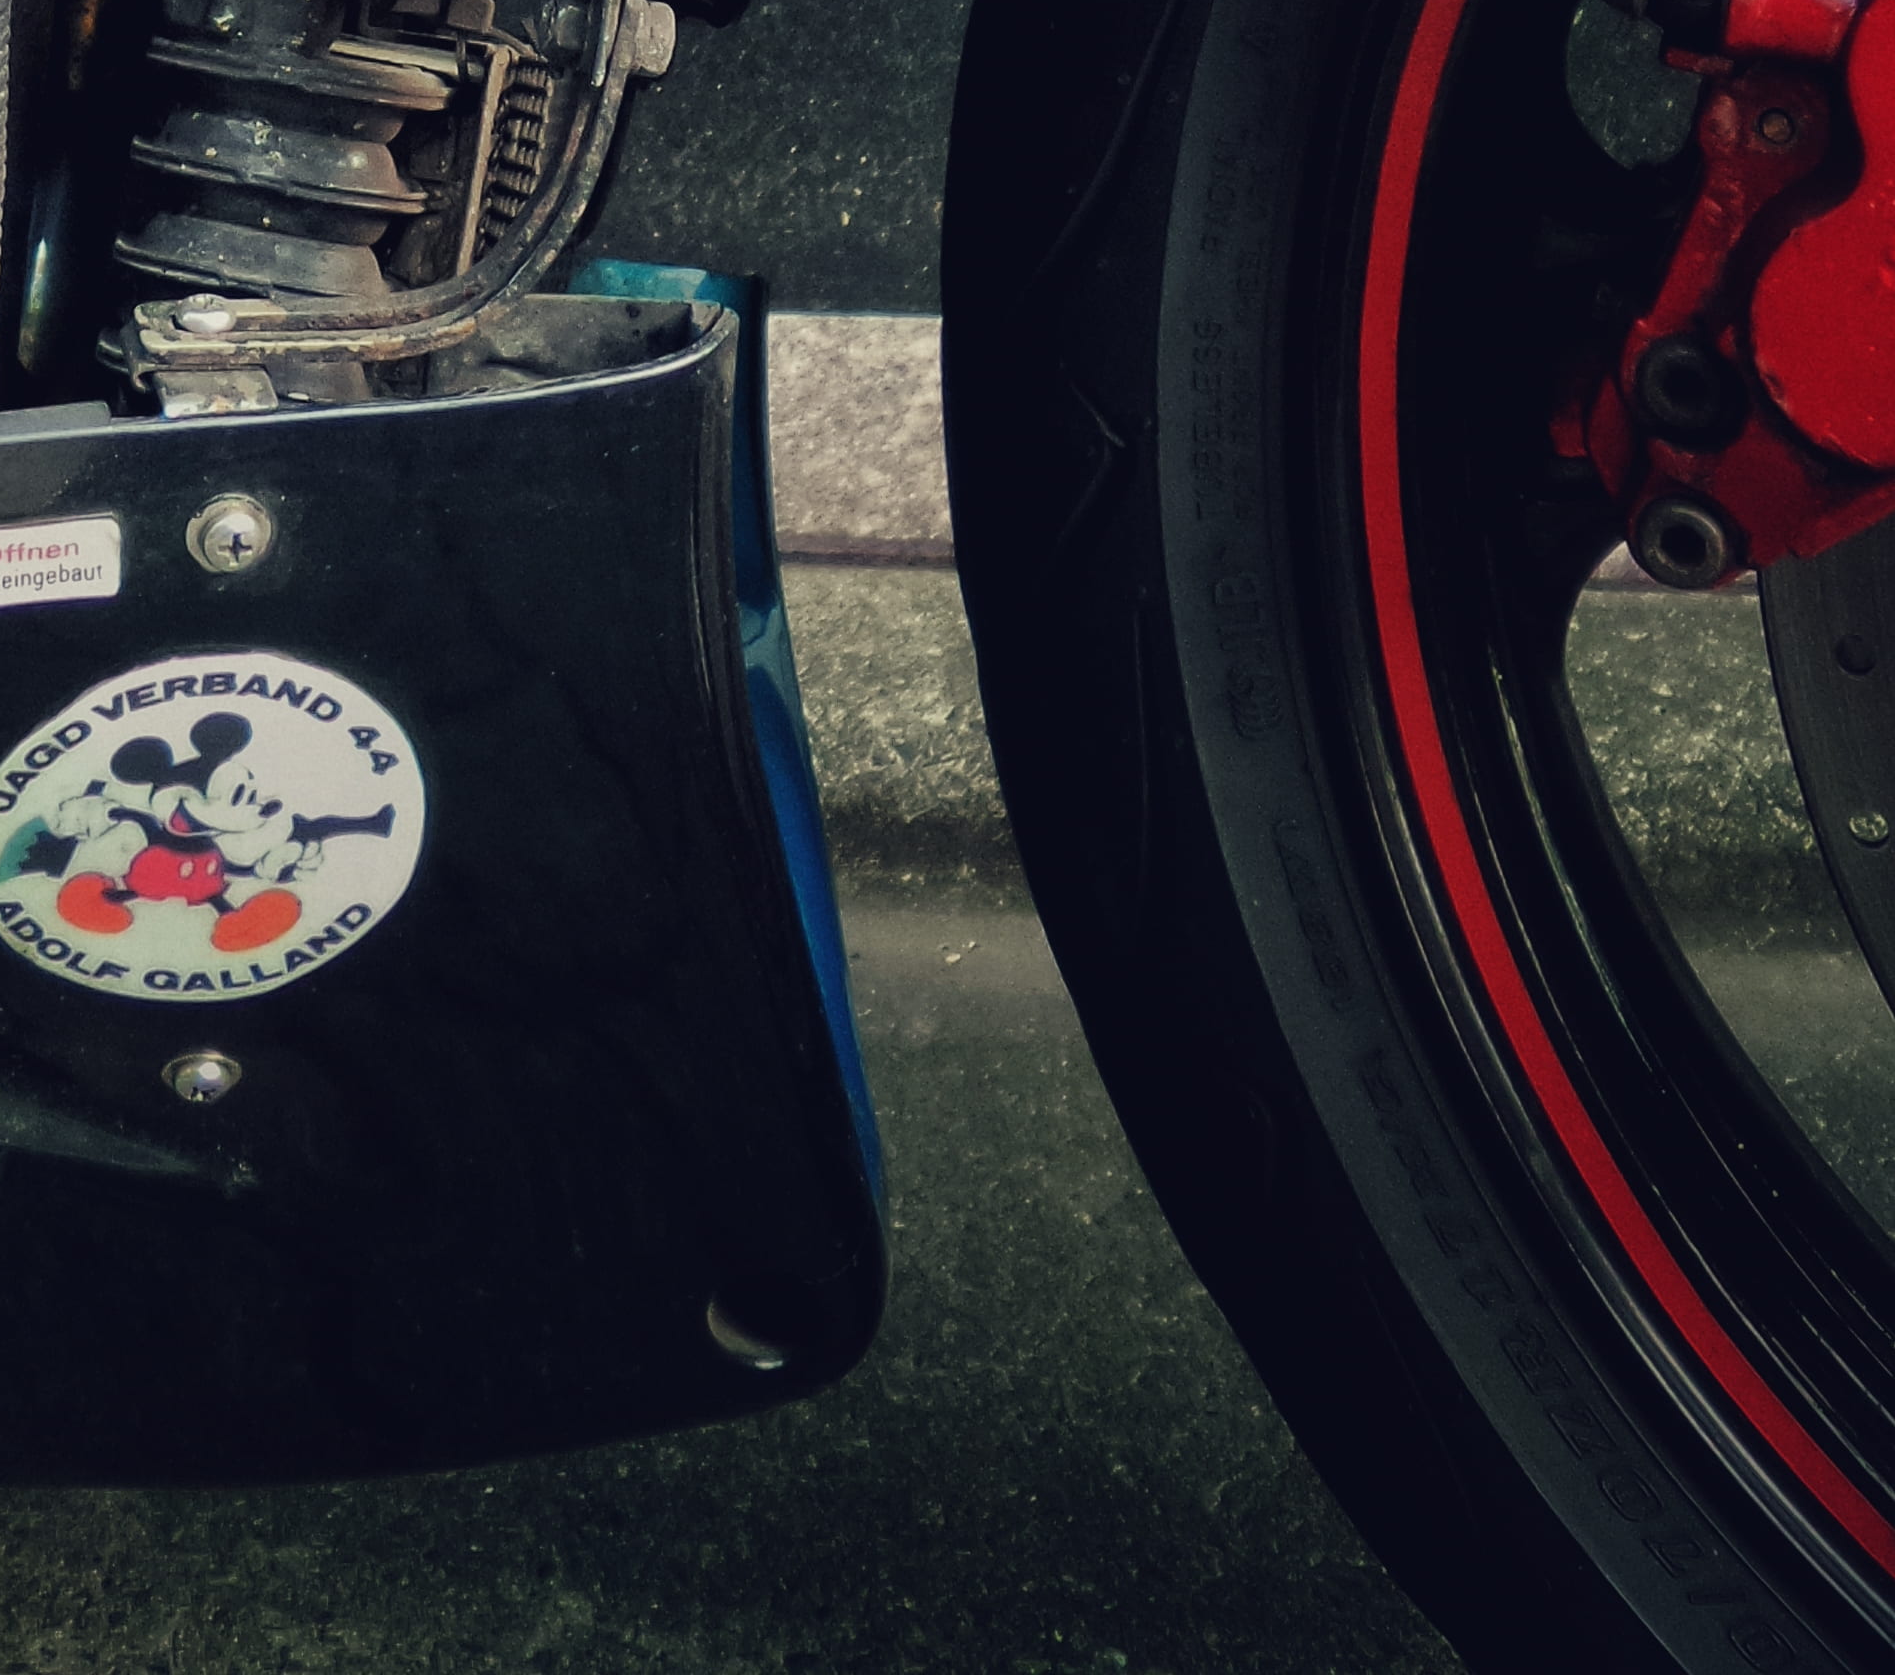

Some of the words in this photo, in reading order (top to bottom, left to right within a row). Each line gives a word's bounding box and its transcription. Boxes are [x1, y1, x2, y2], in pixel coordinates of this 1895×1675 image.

[2, 563, 103, 593] eingebaut
[91, 671, 343, 723] VERBAND
[142, 902, 374, 992] GALLAND
